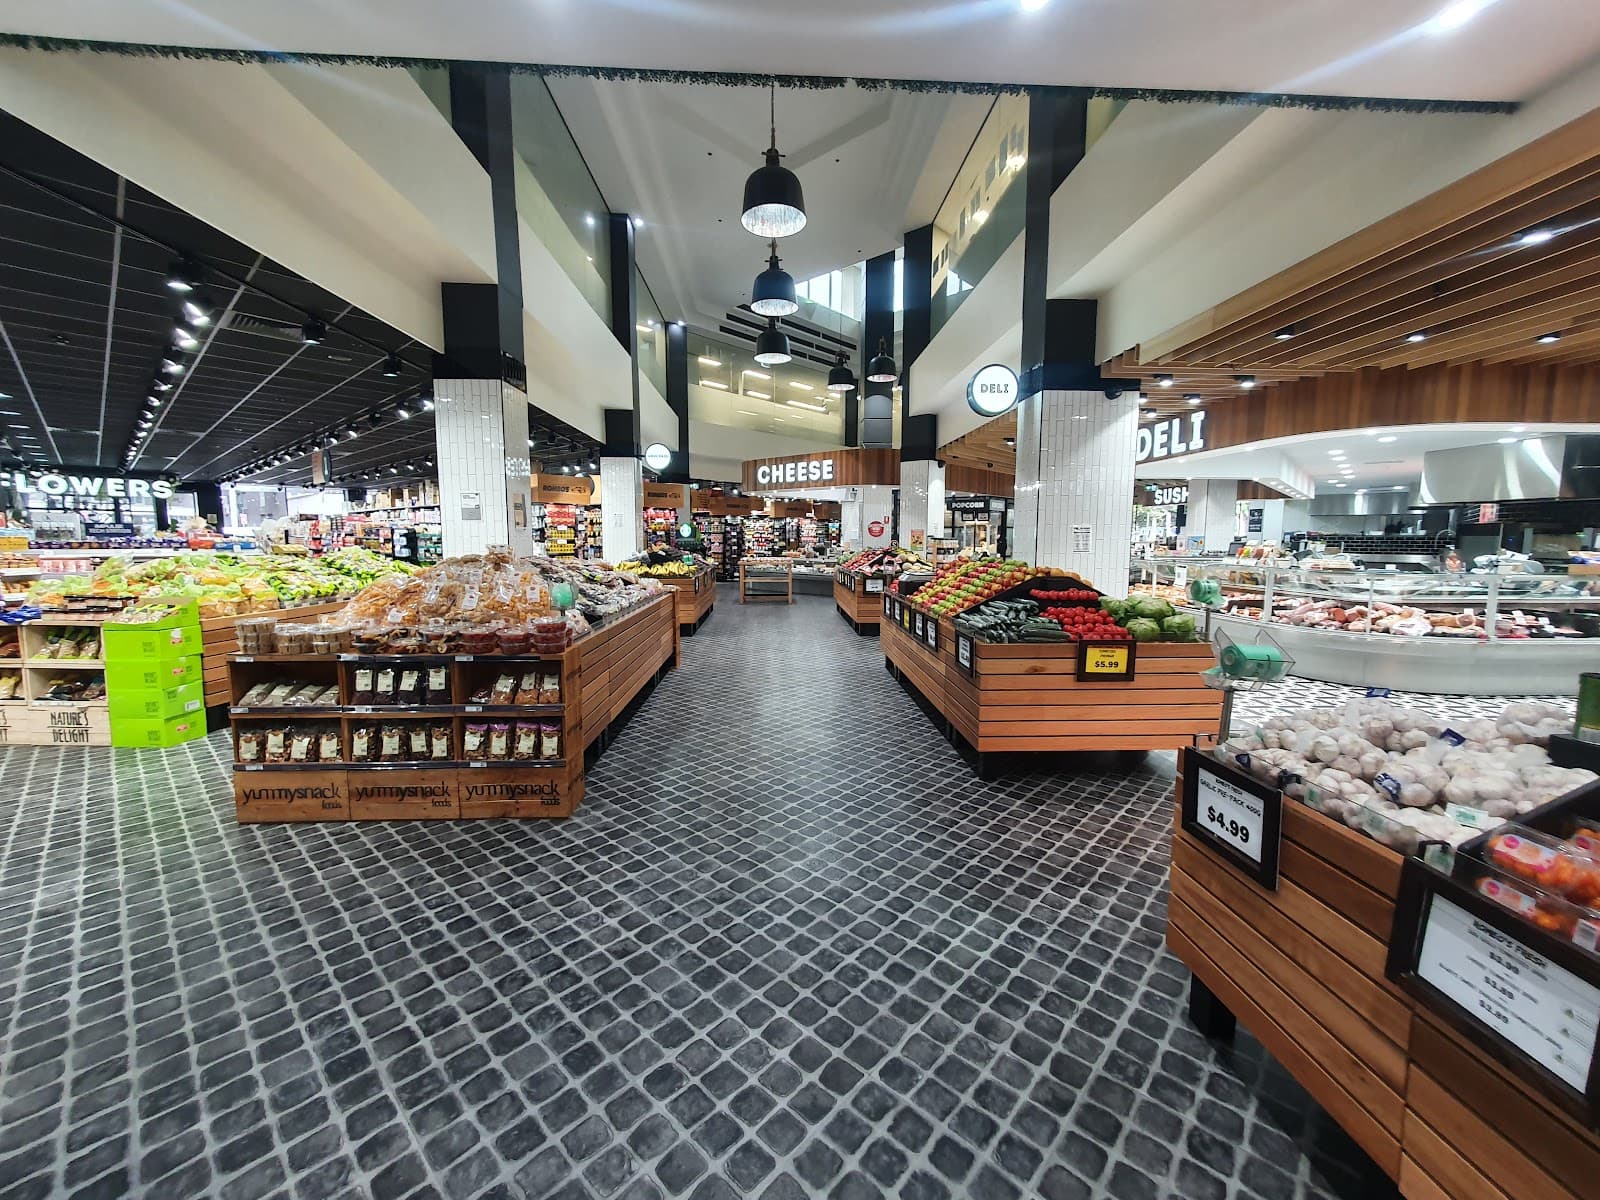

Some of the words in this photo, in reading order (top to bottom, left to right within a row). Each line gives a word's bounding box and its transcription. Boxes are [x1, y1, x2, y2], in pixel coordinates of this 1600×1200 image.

[980, 383, 1009, 394] DELI
[1136, 410, 1206, 462] DELI
[757, 459, 834, 484] CHEESE
[1094, 660, 1119, 669] $5.99
[50, 710, 89, 726] NATURE'S
[52, 728, 90, 743] DELIGHT
[243, 782, 342, 805] yummysnack
[355, 780, 451, 802] yummysnack
[466, 779, 560, 800] yummysnack
[1207, 805, 1250, 844] $4.99
